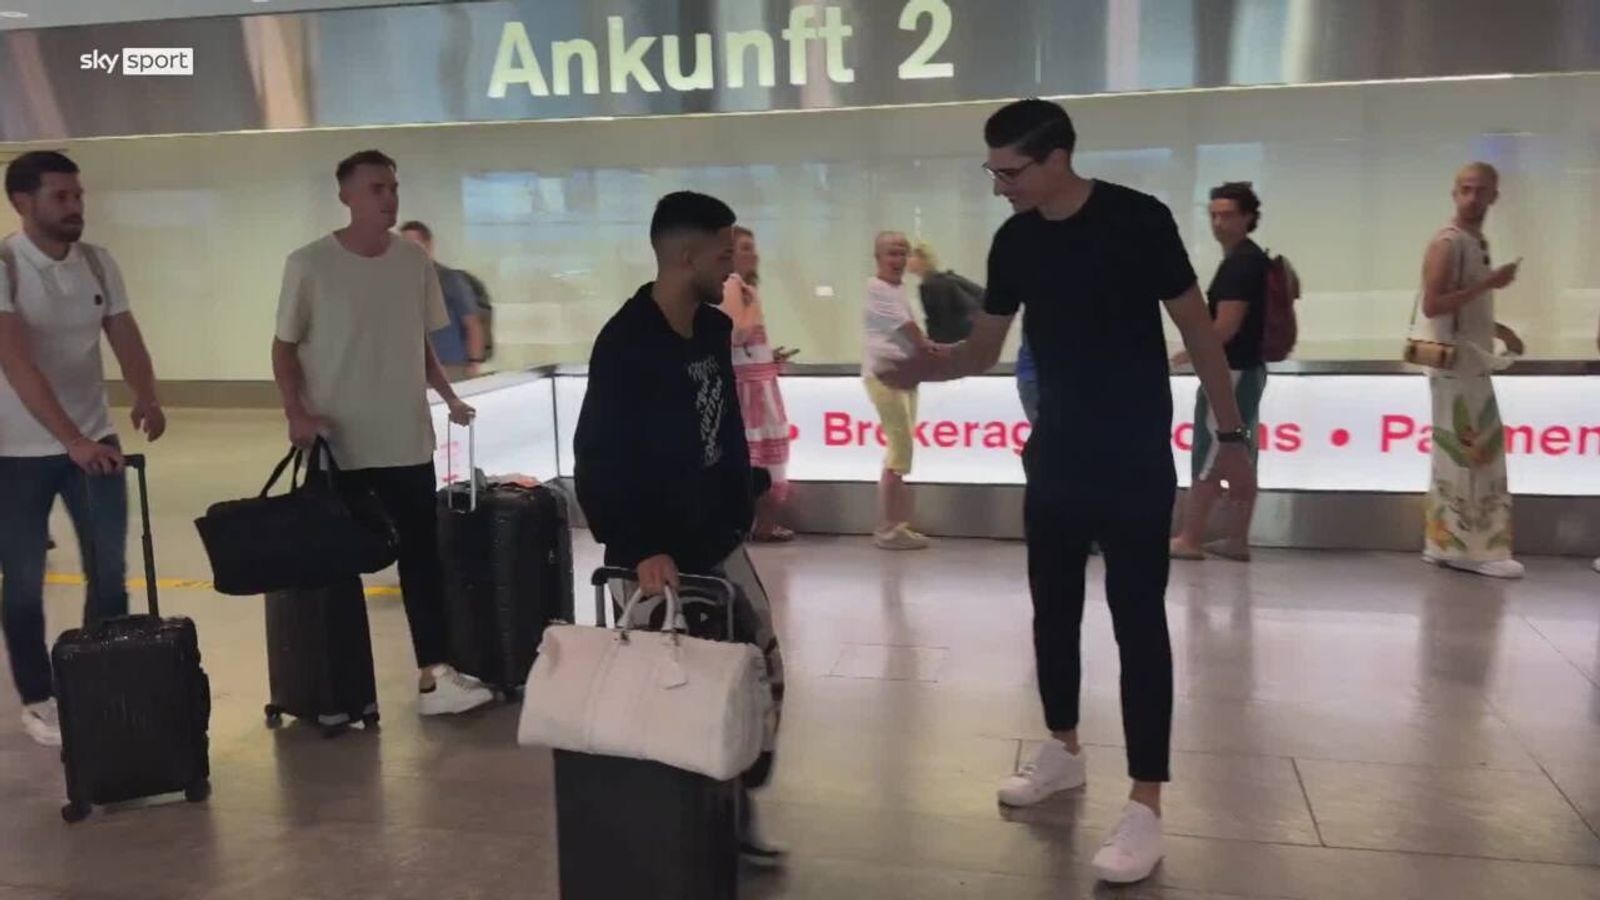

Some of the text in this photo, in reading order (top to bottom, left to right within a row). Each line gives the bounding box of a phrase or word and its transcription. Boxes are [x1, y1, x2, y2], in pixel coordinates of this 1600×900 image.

[487, 0, 954, 98] Ankunft 2
[1380, 414, 1600, 456] Pamen
